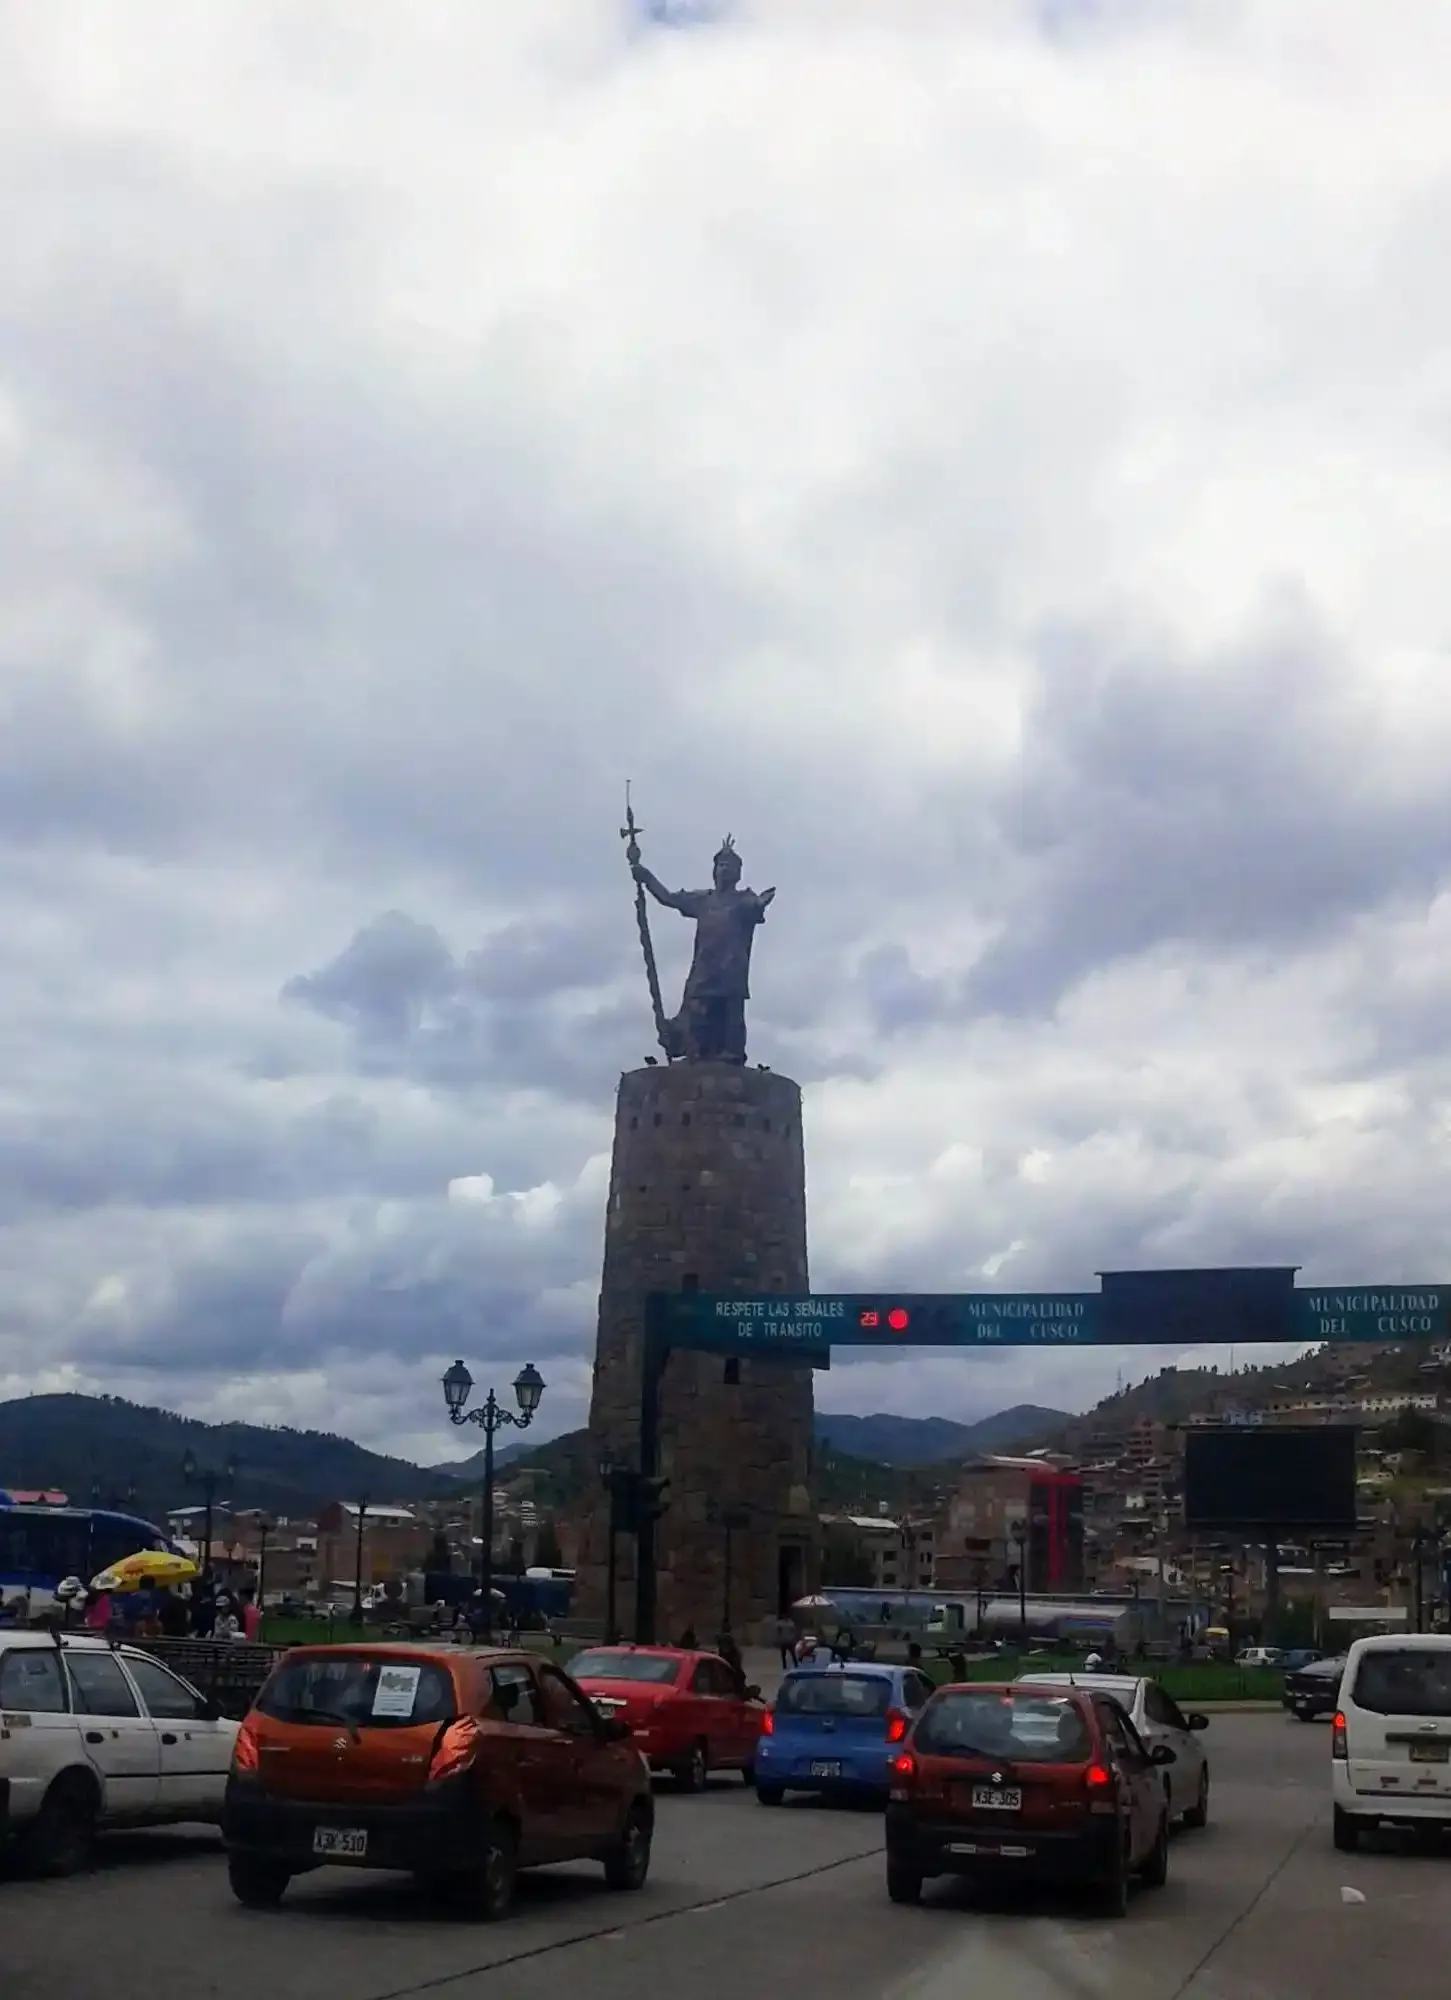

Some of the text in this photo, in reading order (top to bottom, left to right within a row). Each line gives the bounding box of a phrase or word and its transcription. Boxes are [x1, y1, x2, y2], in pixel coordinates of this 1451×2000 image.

[715, 1300, 844, 1317] RESPETE LAS SEÑALES
[968, 1302, 1083, 1318] MUNICIPALIDAD
[1309, 1294, 1439, 1312] MUNICIPALIDAD
[737, 1321, 822, 1338] DE TRANSITO
[976, 1322, 1079, 1338] DEL CUSCO
[1320, 1315, 1431, 1334] DEL CUSCO
